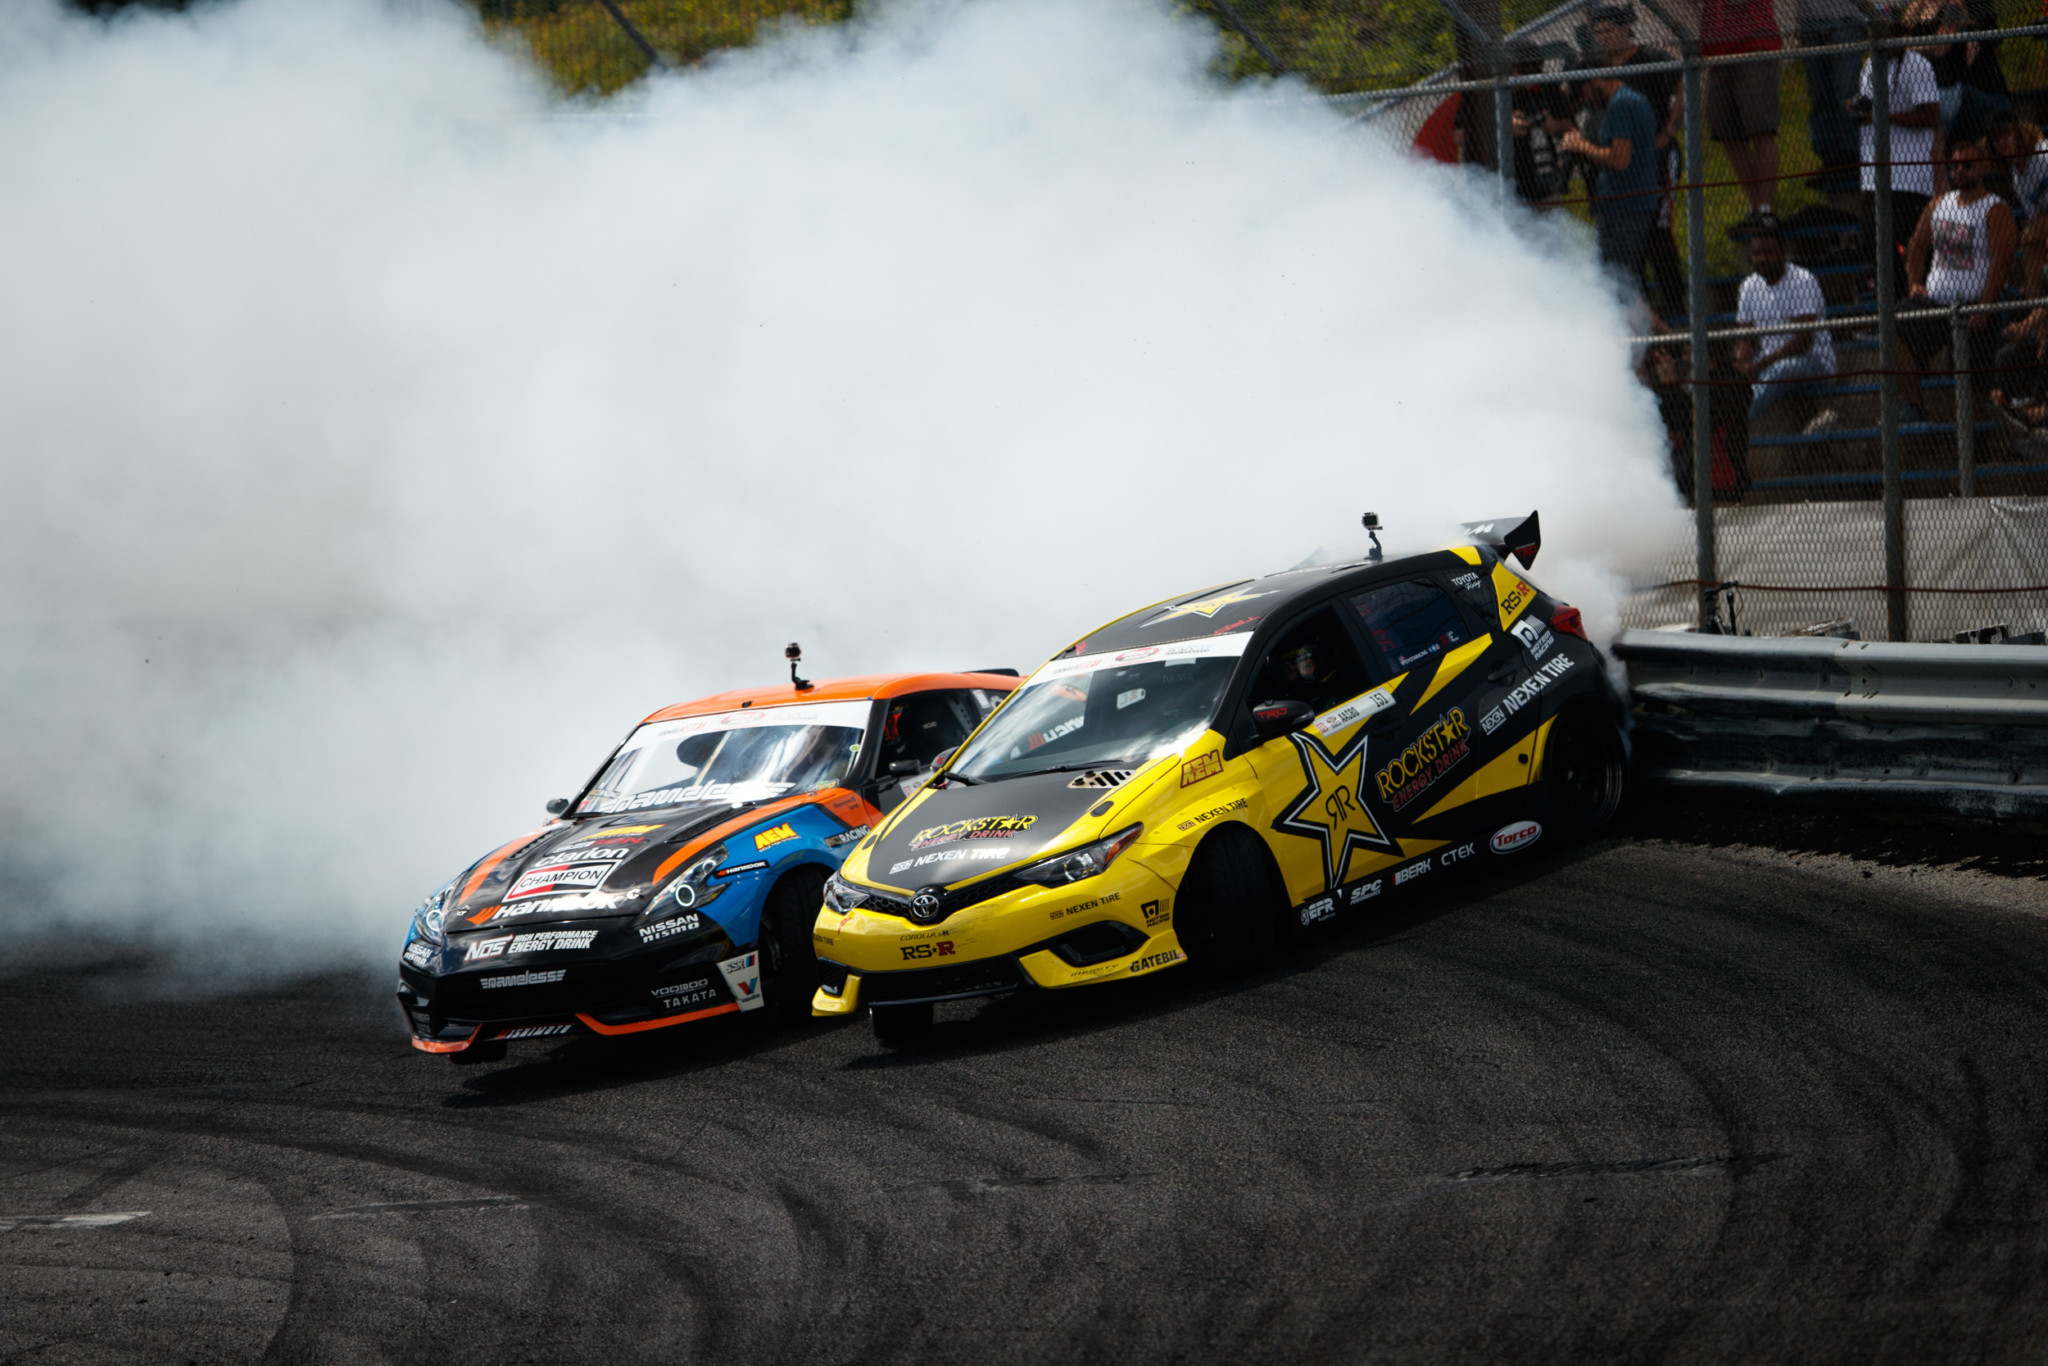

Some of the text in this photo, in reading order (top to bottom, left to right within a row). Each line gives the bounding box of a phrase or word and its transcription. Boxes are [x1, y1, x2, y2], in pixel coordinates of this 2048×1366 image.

[1451, 572, 1479, 586] TOYOTA
[1502, 671, 1552, 716] NEXEN
[1541, 653, 1575, 677] TIRE
[1369, 693, 1389, 708] 151
[1180, 749, 1224, 789] AEM
[1392, 738, 1468, 809] ENERGY DRINK
[1194, 806, 1230, 823] NEXEN
[1226, 798, 1249, 811] TIRE
[839, 824, 871, 844] RACING
[970, 830, 1013, 839] DRINK
[1496, 825, 1537, 847] Torco
[914, 849, 969, 867] NEXEN
[1441, 843, 1476, 866] CTEK
[520, 869, 604, 888] CHAMPION
[1399, 858, 1432, 883] BERK
[1350, 879, 1382, 901] SPC
[1065, 900, 1099, 916] NEXEN
[1100, 892, 1121, 905] TIRE
[514, 930, 599, 942] HIGH PERFORMANCE
[639, 913, 699, 937] NISSAN
[507, 938, 595, 954] ENERGY DRINK
[900, 931, 936, 942] COROLLA
[1130, 949, 1180, 973] GATEBIL
[663, 989, 717, 1009] TAKATA
